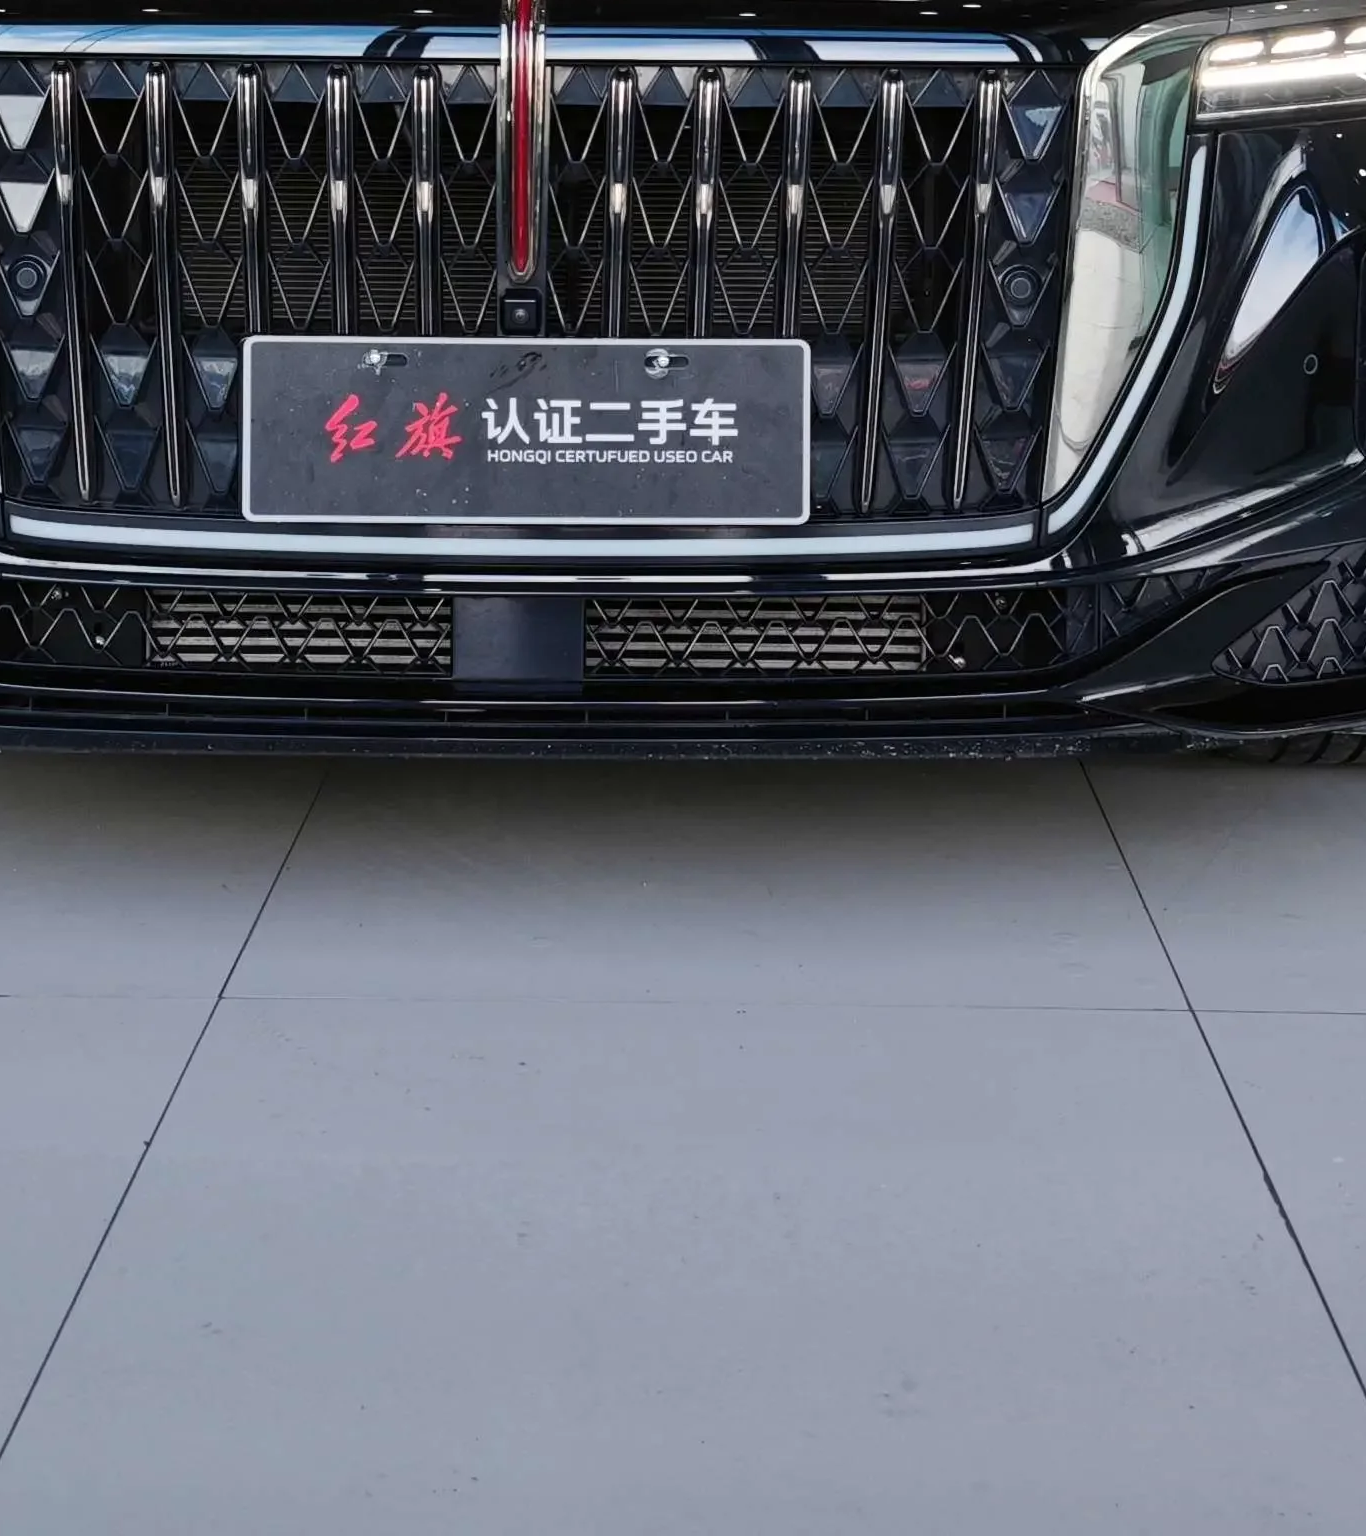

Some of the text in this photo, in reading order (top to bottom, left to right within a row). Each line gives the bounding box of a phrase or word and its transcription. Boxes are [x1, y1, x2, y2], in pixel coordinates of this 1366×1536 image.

[325, 393, 739, 463] 红旗 认证二手车
[487, 449, 552, 465] HONGQI
[700, 449, 733, 463] CAR
